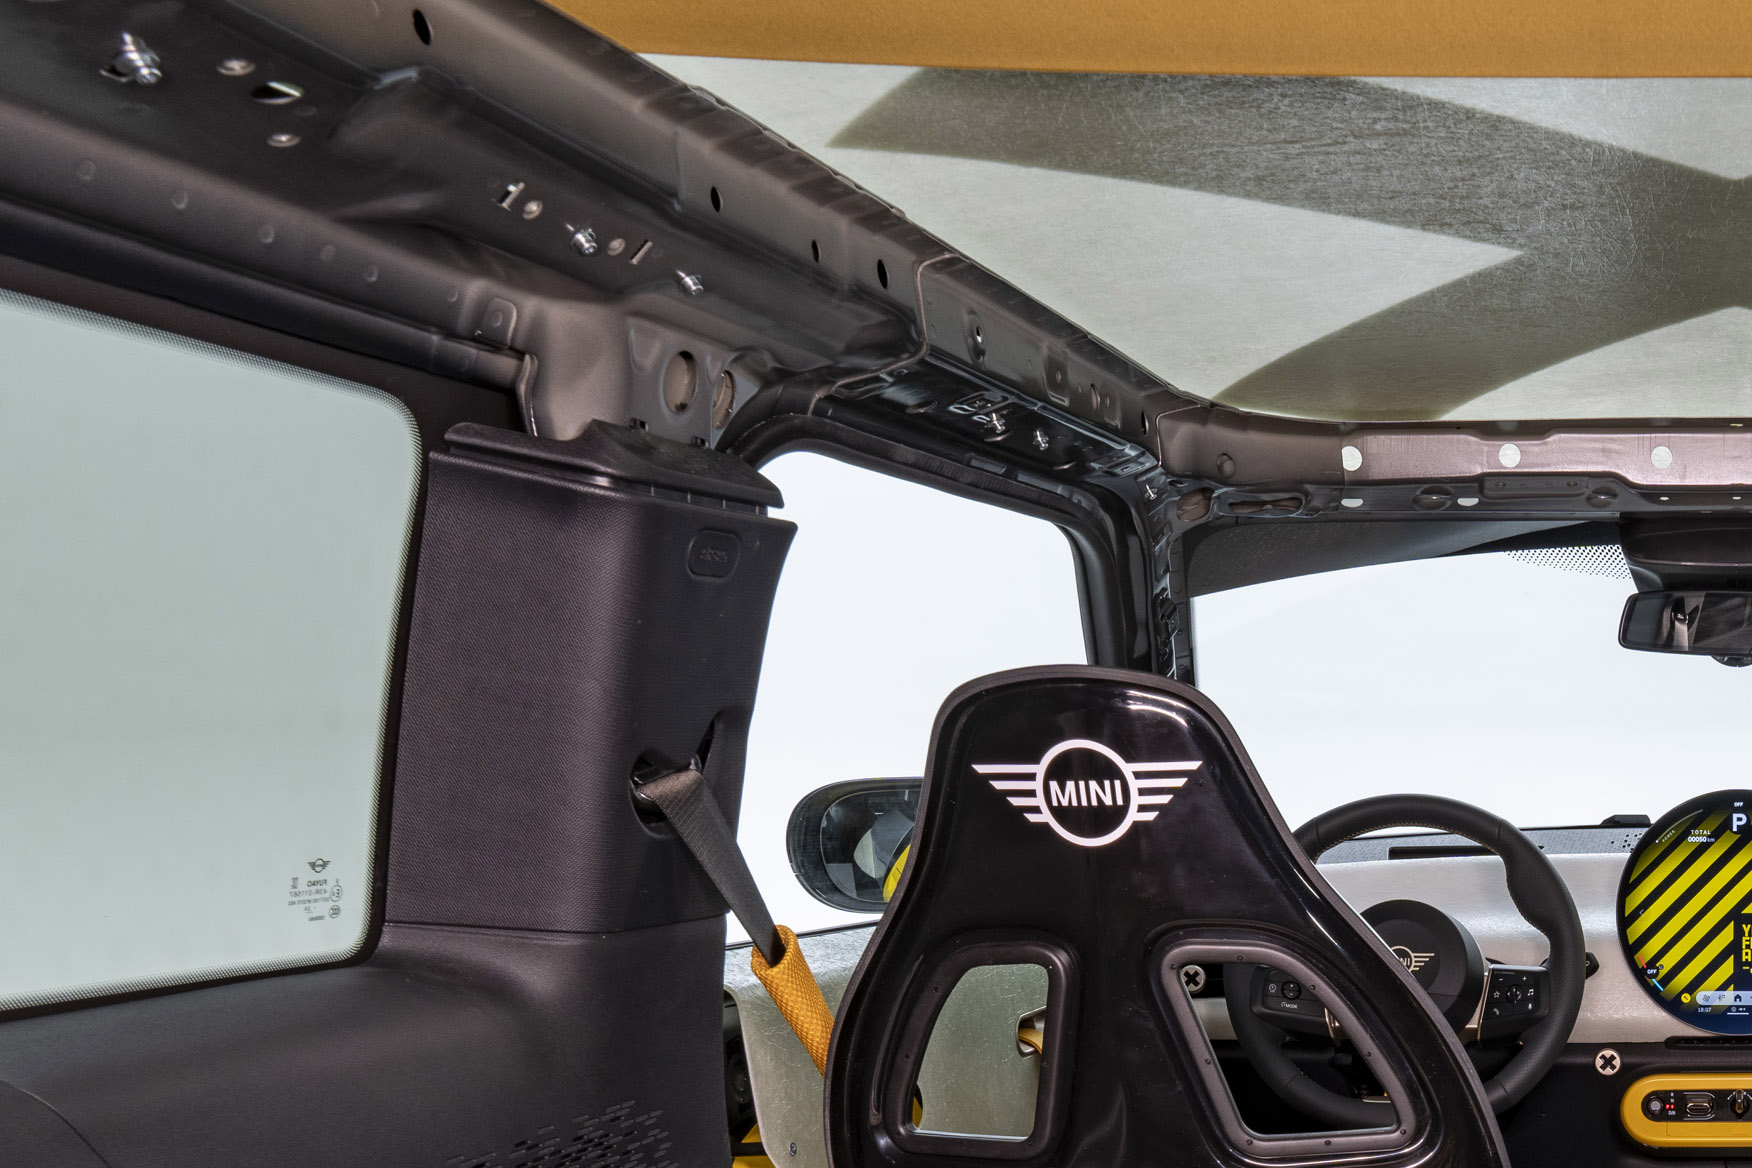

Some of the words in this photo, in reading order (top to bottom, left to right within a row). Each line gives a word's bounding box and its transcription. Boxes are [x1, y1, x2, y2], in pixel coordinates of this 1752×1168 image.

[1049, 780, 1124, 806] MINI
[1732, 813, 1747, 832] P
[1662, 830, 1675, 843] POWER
